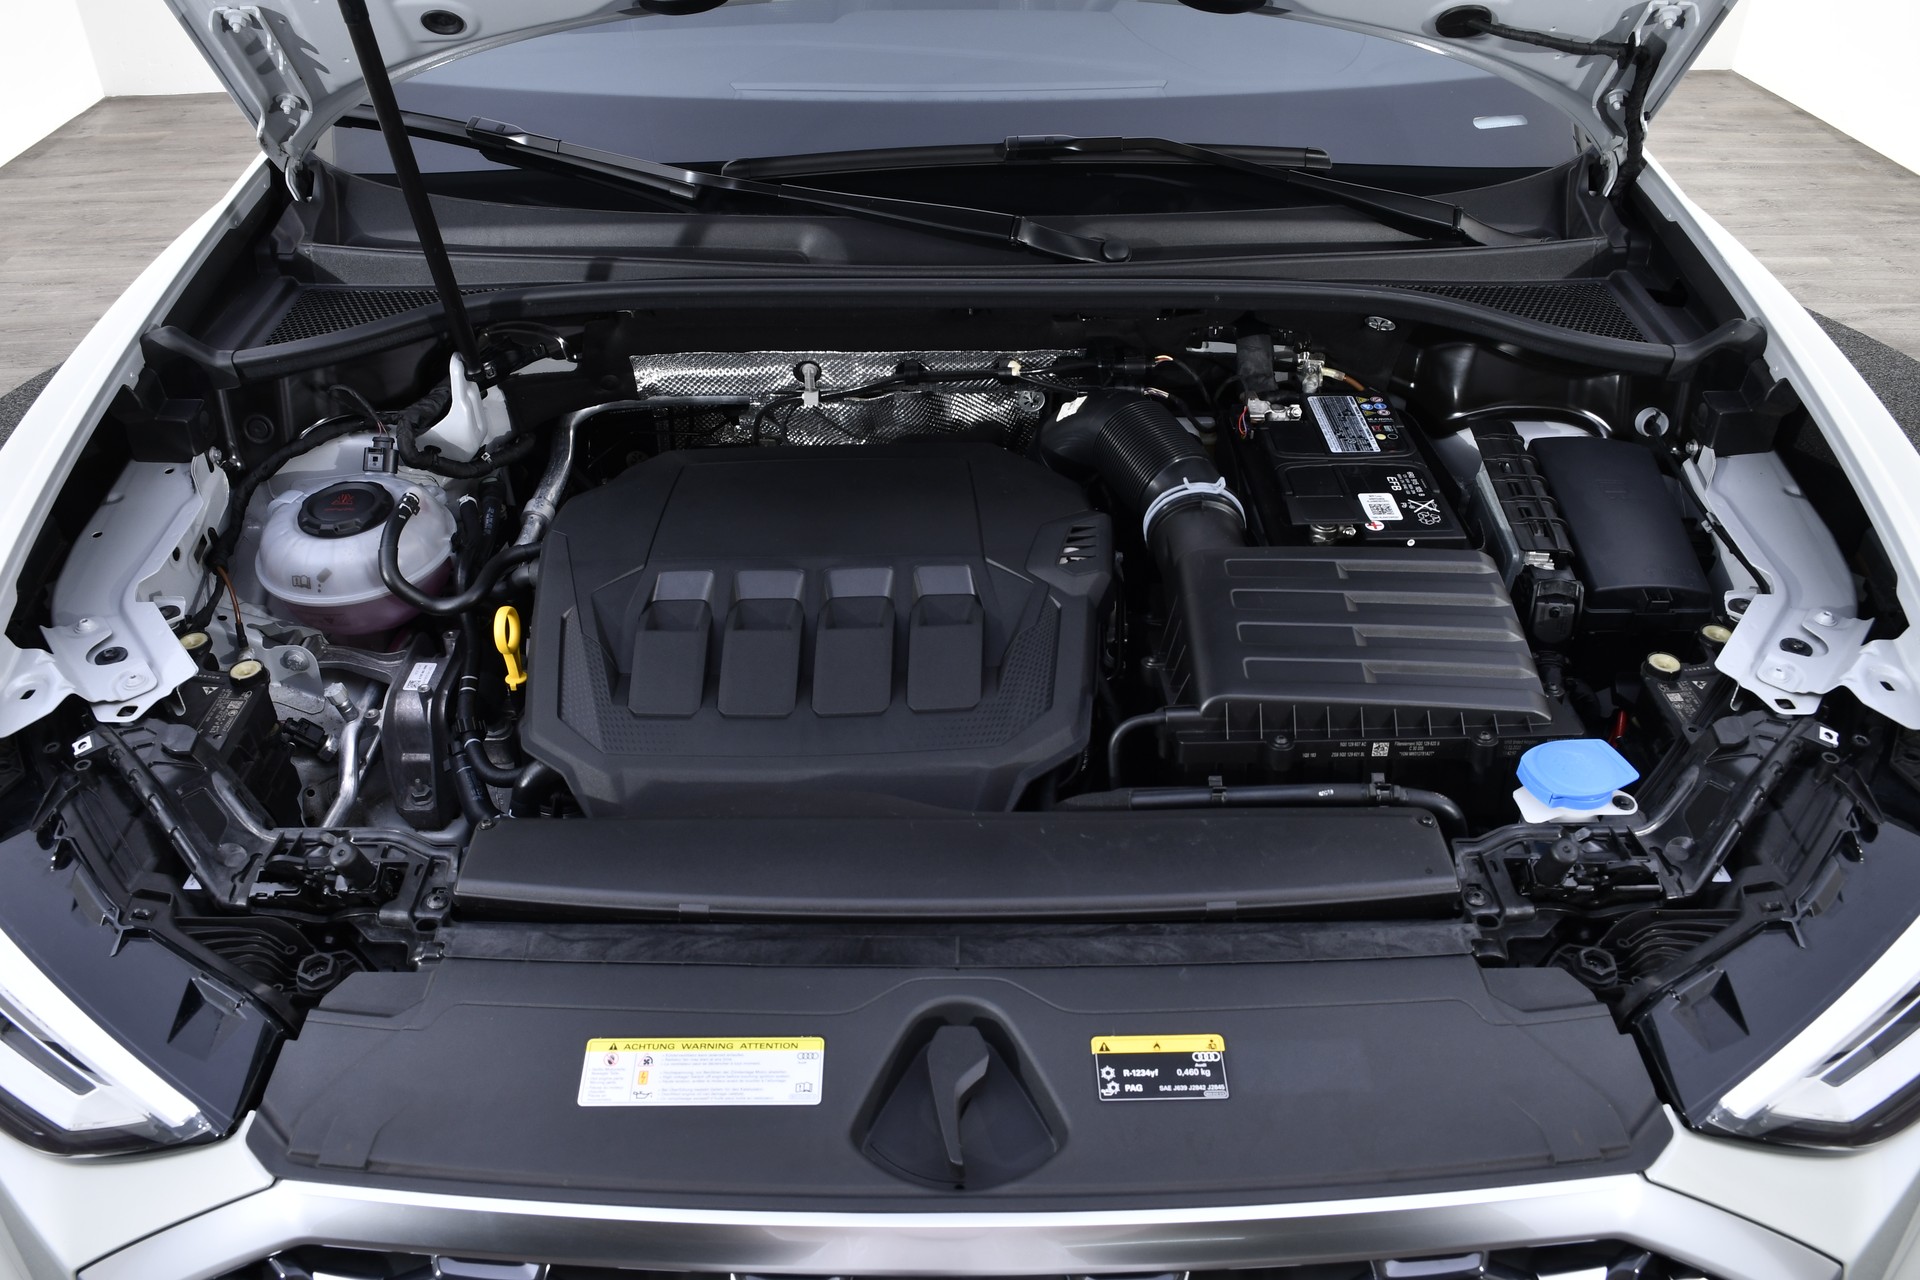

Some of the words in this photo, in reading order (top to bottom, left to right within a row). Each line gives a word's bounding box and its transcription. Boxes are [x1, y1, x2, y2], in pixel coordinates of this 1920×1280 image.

[1386, 476, 1402, 491] EFB
[623, 1042, 675, 1050] ACHTUNG
[681, 1042, 734, 1050] WARNING
[740, 1042, 799, 1050] ATTENTION
[1123, 1068, 1159, 1078] R-1234yf
[1176, 1068, 1199, 1077] 0,460
[1200, 1068, 1211, 1077] kg
[1124, 1084, 1143, 1093] PAG
